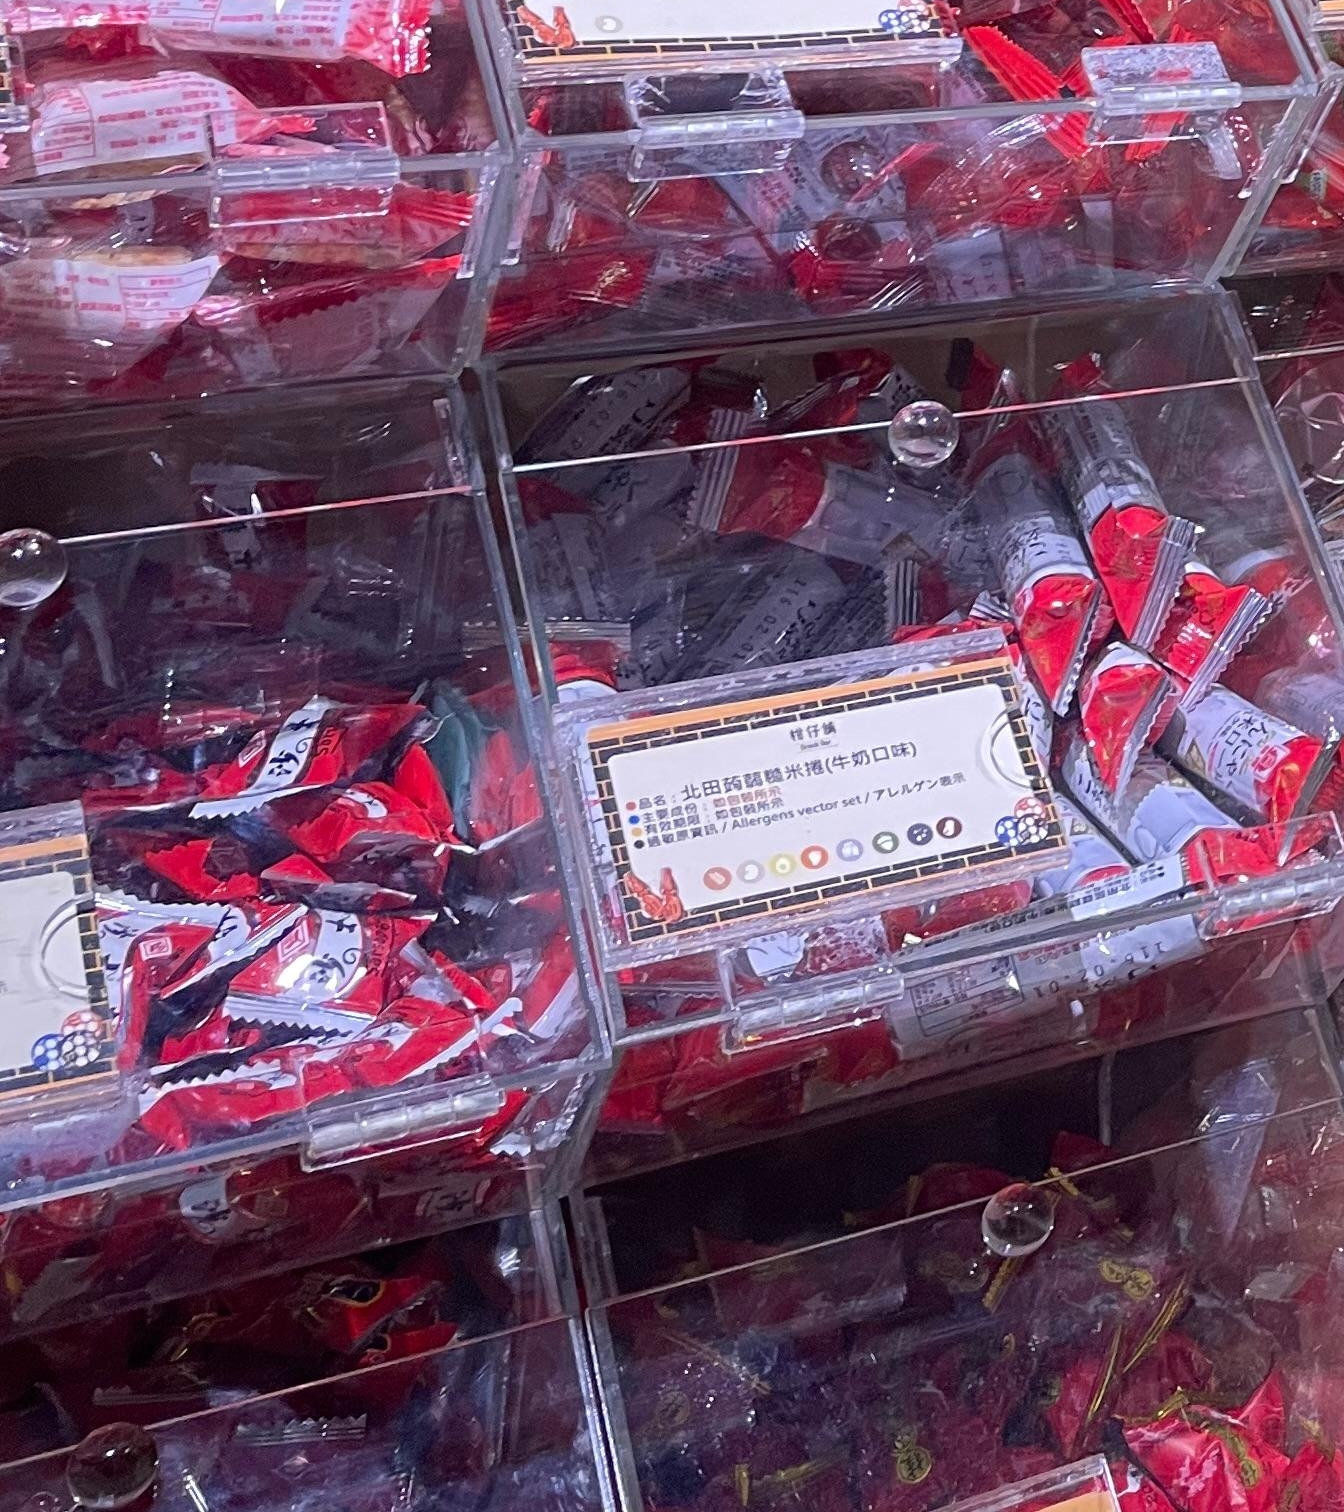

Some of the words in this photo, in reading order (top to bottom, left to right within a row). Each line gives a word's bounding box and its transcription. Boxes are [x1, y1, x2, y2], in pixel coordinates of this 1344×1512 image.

[730, 807, 796, 832] Allergens
[796, 798, 839, 817] vector
[840, 793, 862, 808] set
